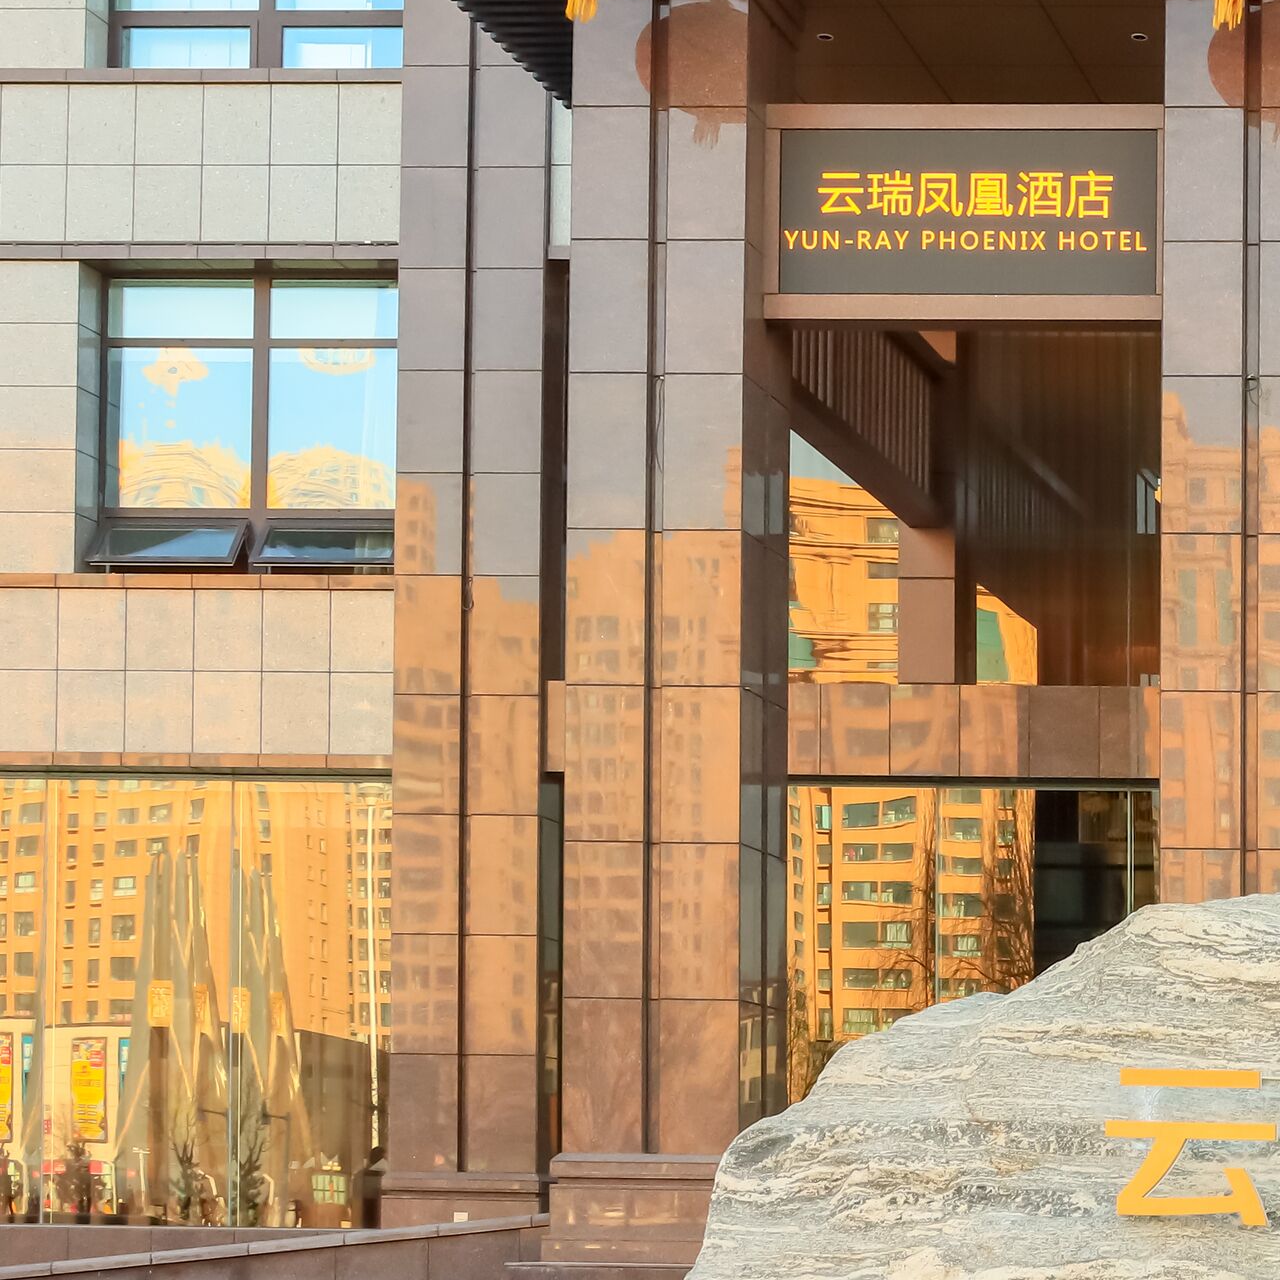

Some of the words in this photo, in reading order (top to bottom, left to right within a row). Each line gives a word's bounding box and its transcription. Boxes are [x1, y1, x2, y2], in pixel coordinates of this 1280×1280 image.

[816, 170, 1114, 219] 云瑞凤凰酒店
[783, 229, 908, 251] YUN-RAY
[920, 229, 1047, 251] PHOENIX
[1057, 229, 1148, 251] HOTEL
